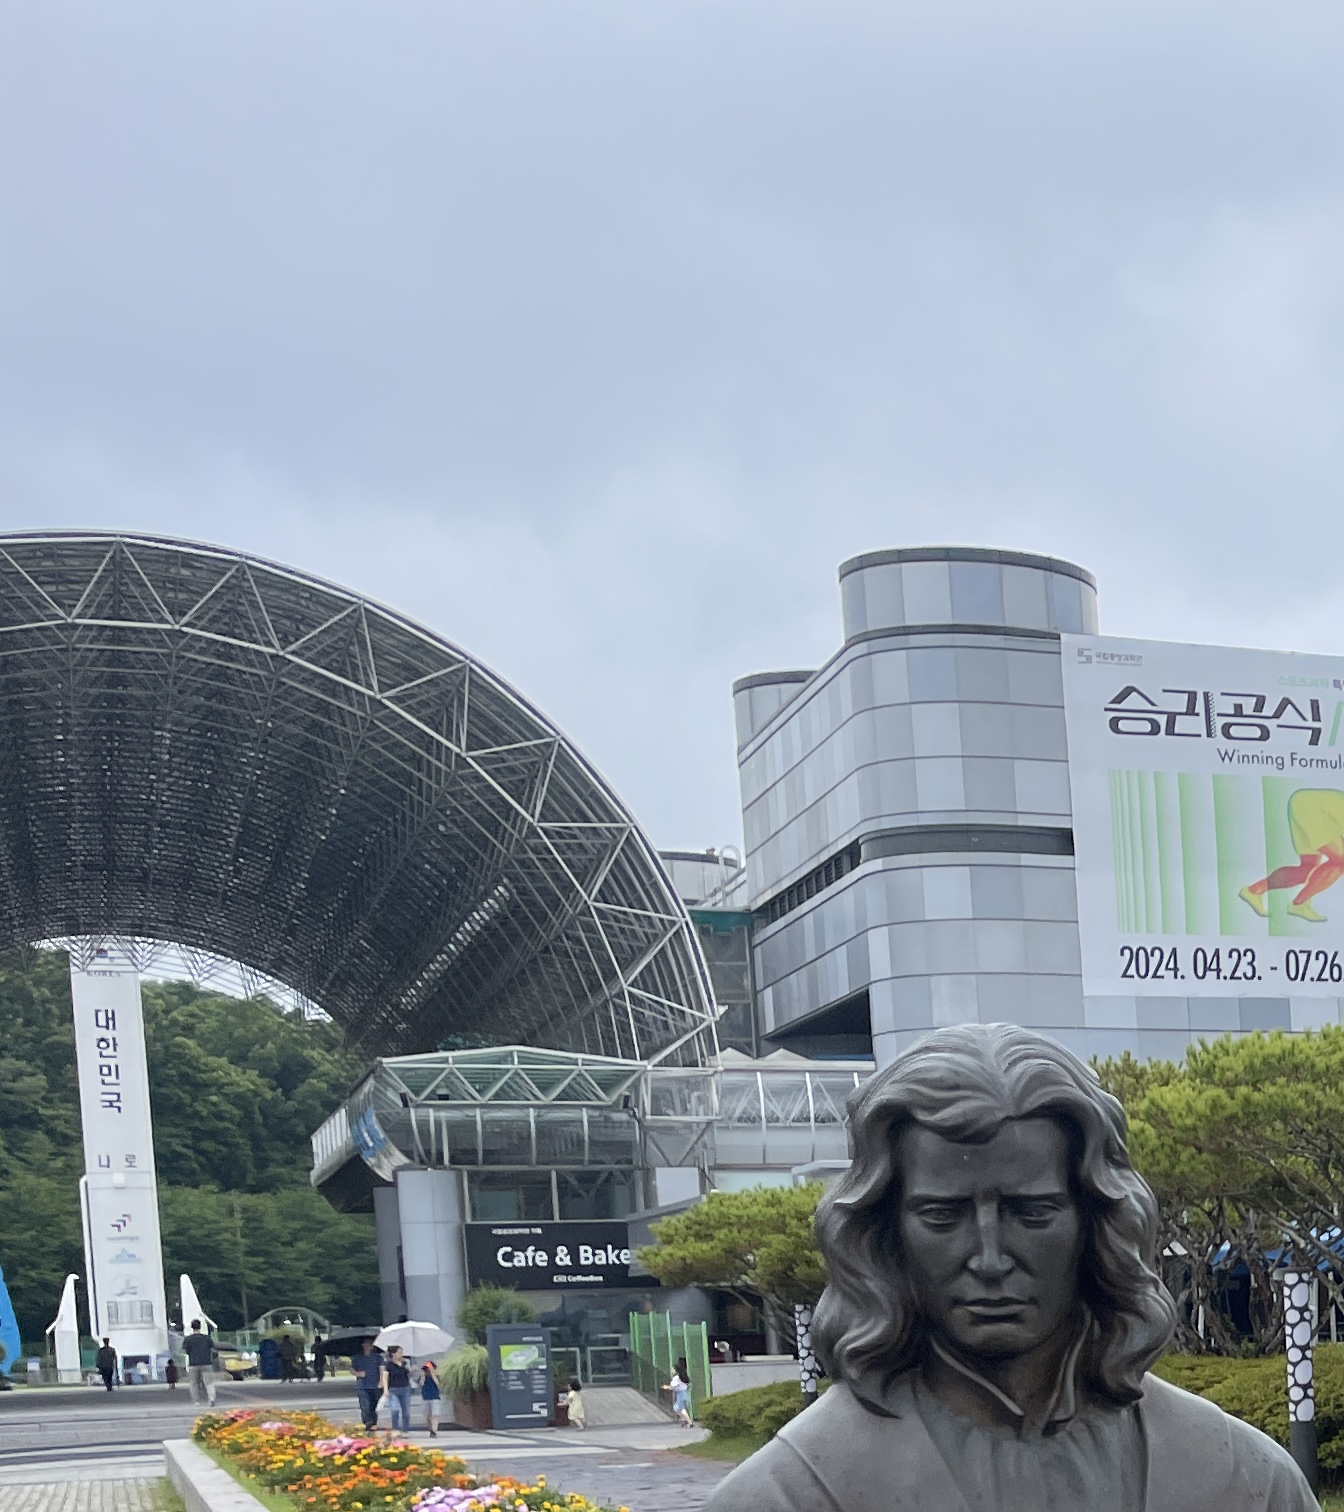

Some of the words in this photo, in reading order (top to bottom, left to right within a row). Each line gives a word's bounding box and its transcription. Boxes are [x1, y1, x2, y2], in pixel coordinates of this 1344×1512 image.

[1104, 685, 1322, 746] 승리공식
[1217, 748, 1285, 770] Winning
[1119, 945, 1186, 980] 2024.
[1193, 947, 1263, 981] 04.23.
[94, 1008, 122, 1114] 대한민국
[497, 1245, 549, 1268] Cafe
[555, 1245, 572, 1266] &
